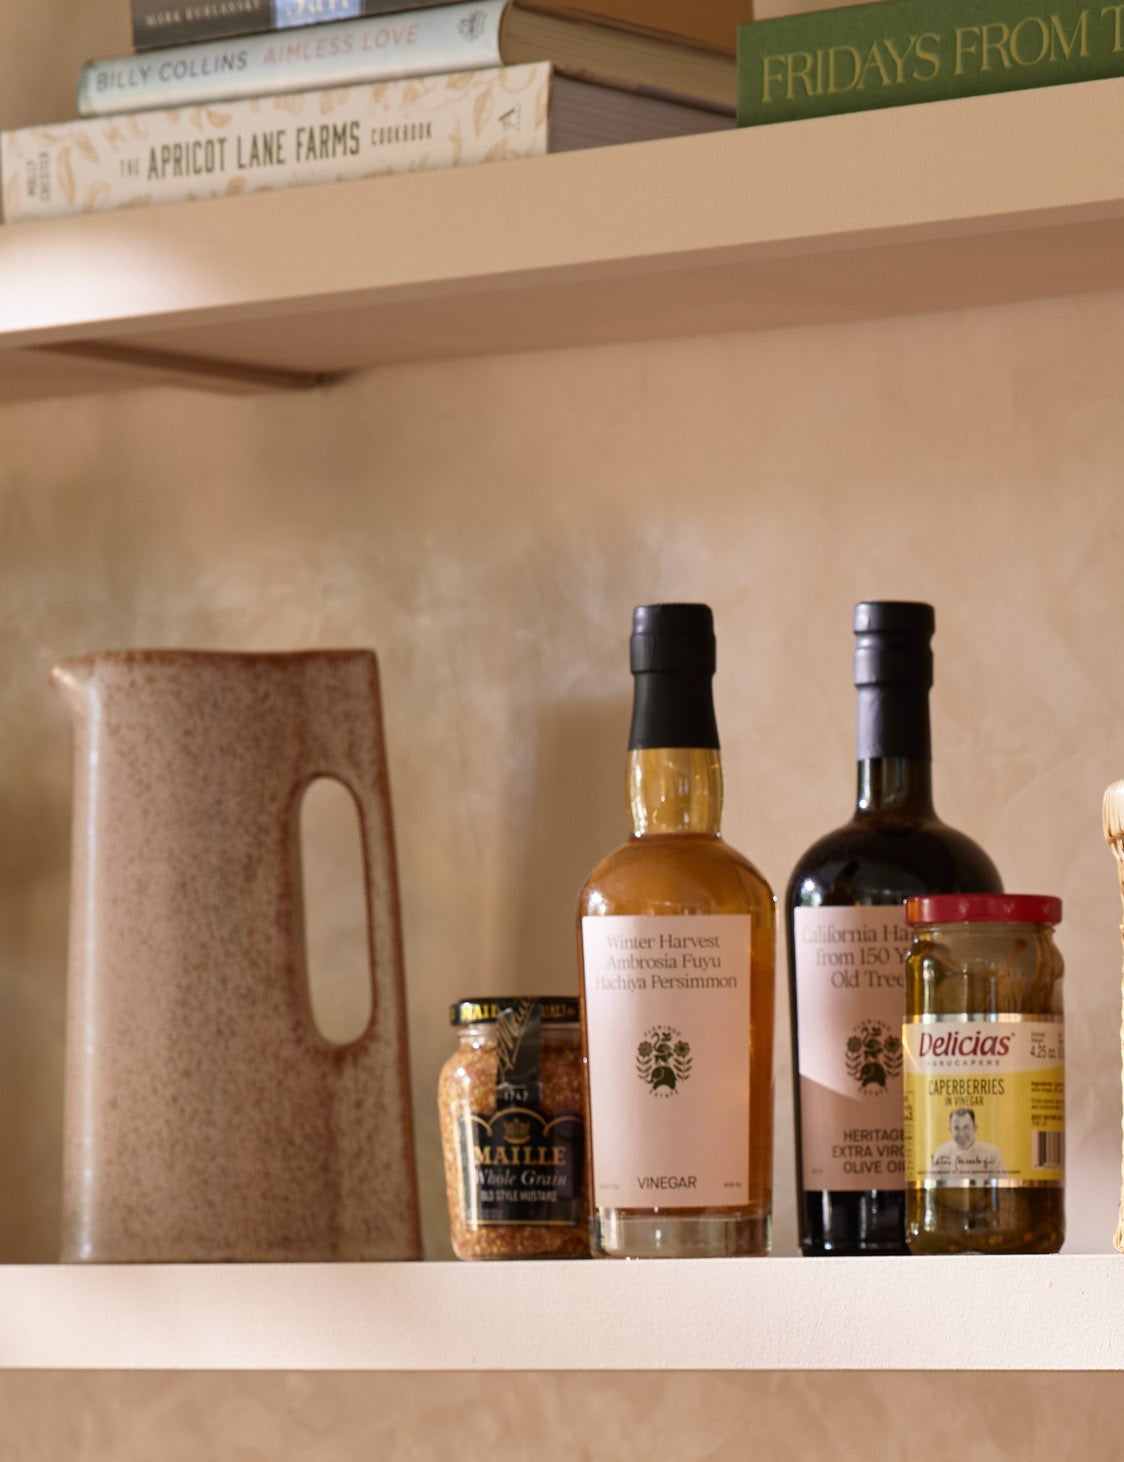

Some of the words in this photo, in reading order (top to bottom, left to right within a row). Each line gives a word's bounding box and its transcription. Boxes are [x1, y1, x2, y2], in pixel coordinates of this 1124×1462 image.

[96, 65, 152, 92] BILLY
[158, 50, 249, 82] COLLINS
[263, 32, 354, 65] AIMLESS
[361, 24, 420, 52] LOVE
[761, 32, 941, 103] FRIDAYS
[953, 9, 1091, 76] FROM
[120, 158, 141, 177] THE
[147, 137, 227, 181] APRICOT
[237, 129, 286, 169] LANE
[296, 121, 361, 163] FARMS
[371, 121, 433, 146] COOKBOOK
[606, 934, 655, 949] Winter
[659, 934, 720, 949] Harvest
[802, 925, 878, 943] California
[605, 955, 678, 971] Ambrosia
[682, 954, 722, 972] Fuyu
[816, 947, 855, 966] from
[595, 974, 647, 993] Hachiya
[651, 974, 738, 989] Persimmon
[831, 970, 859, 988] Old
[864, 970, 905, 988] Tree
[919, 1031, 1012, 1058] Delicias
[928, 1079, 1005, 1095] CAPERBERRIES
[955, 1096, 985, 1106] VINEGAR
[473, 1146, 567, 1167] MAILLE
[832, 1146, 873, 1159] EXTRA
[475, 1168, 517, 1186] Whole
[521, 1168, 567, 1186] Grain
[843, 1161, 883, 1175] OLIVE
[637, 1176, 698, 1189] VINEGAR
